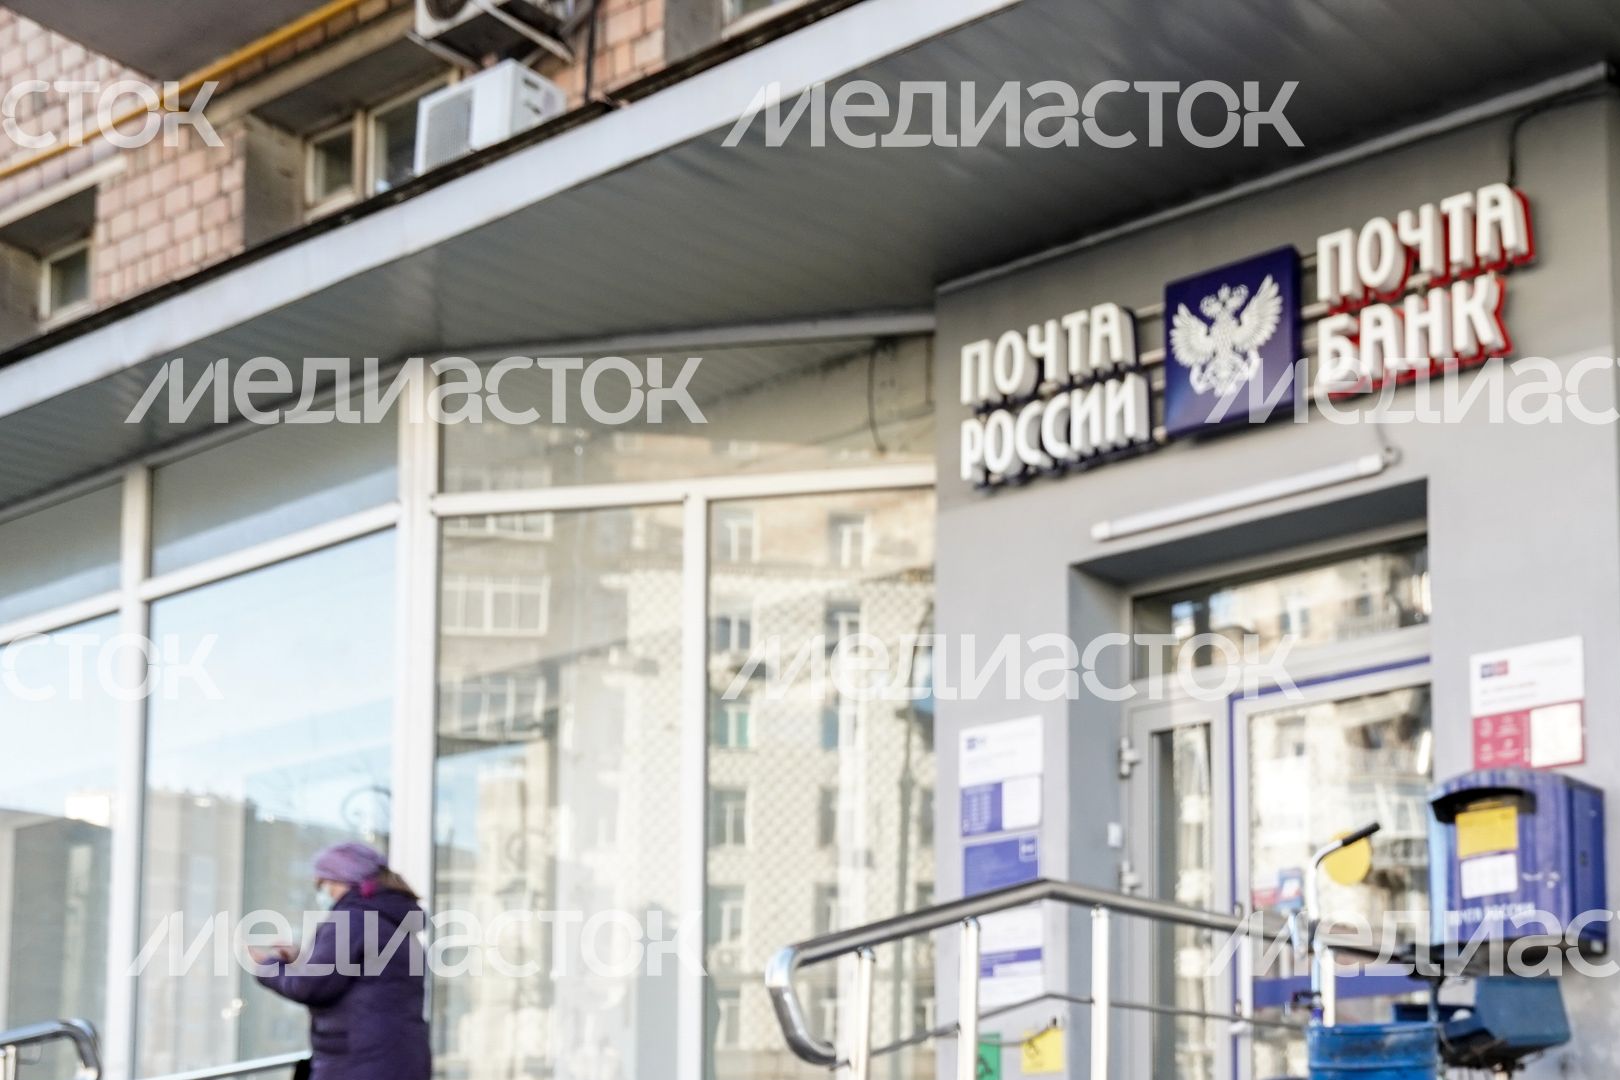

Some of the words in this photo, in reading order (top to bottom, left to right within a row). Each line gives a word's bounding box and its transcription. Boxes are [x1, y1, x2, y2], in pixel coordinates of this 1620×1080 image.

[1316, 183, 1531, 306] ПОЧТА
[961, 301, 1136, 405] ПОЧТА
[1317, 269, 1508, 390] БАНК
[961, 373, 1149, 482] РОССИИ
